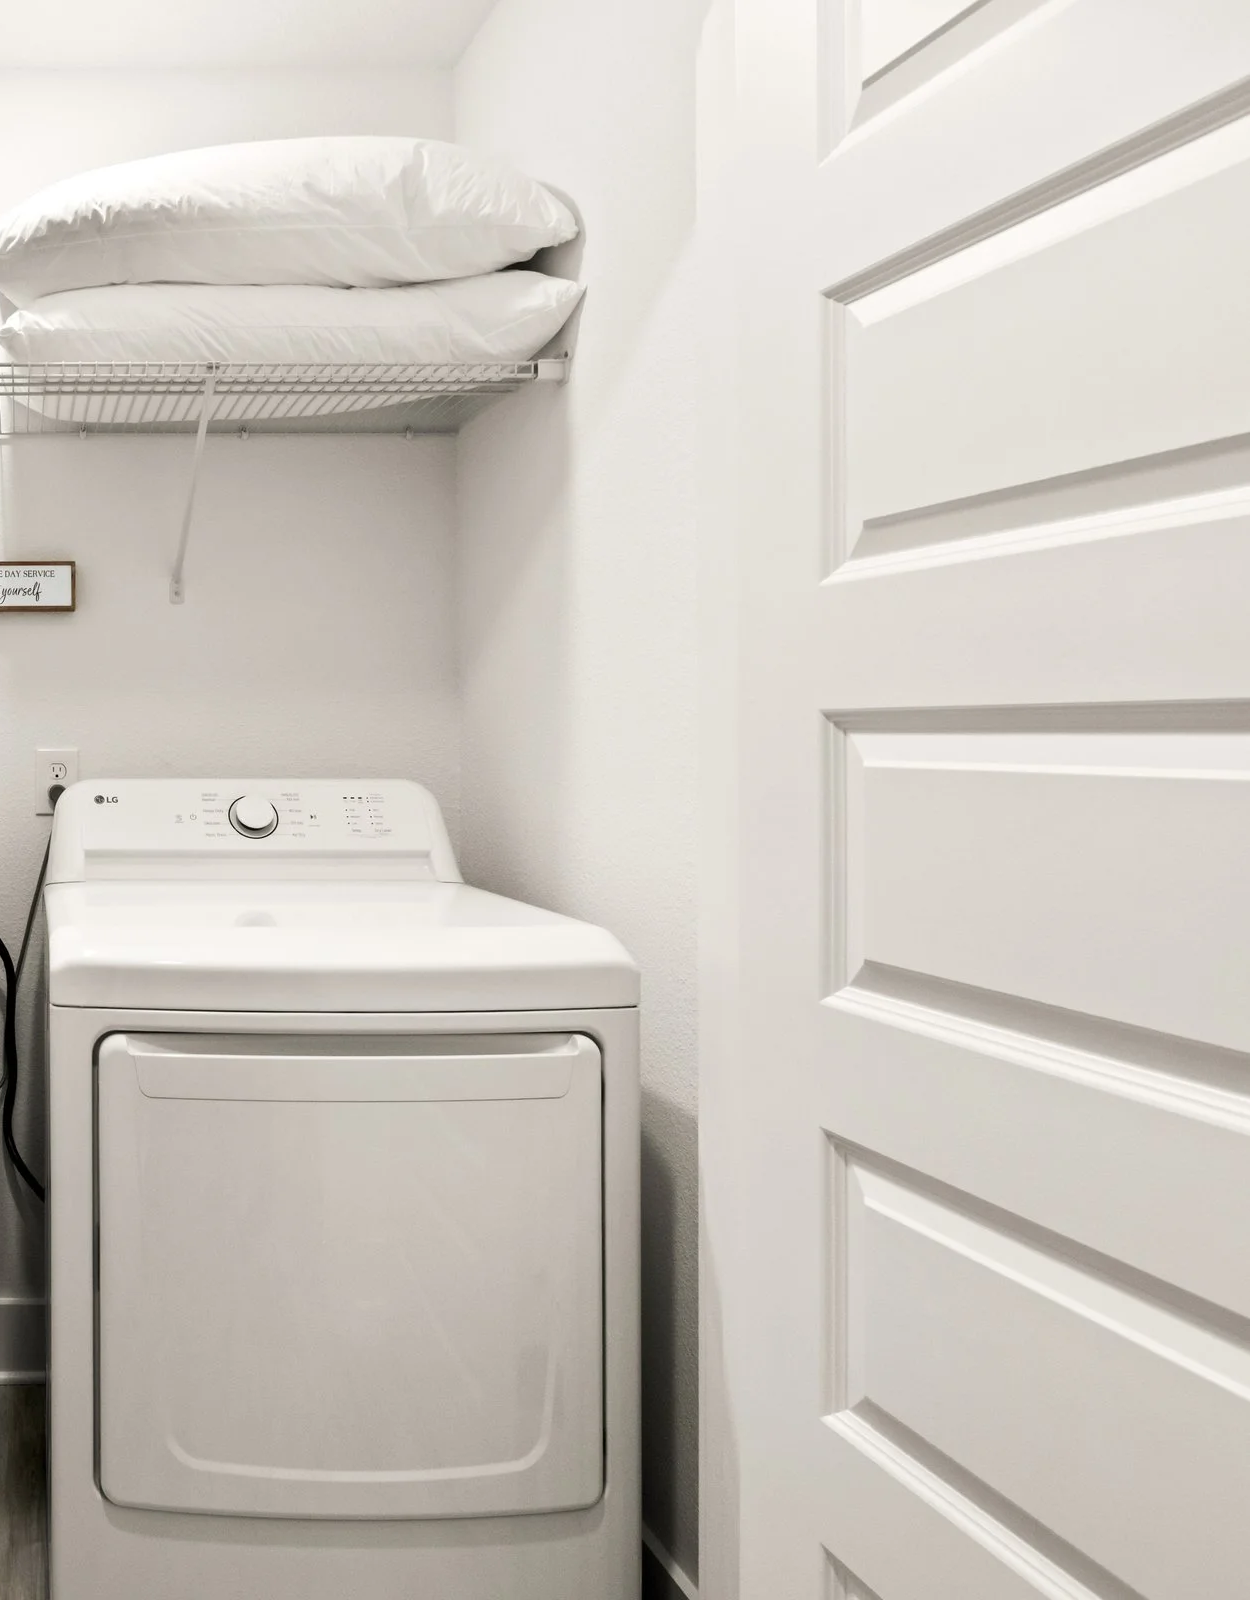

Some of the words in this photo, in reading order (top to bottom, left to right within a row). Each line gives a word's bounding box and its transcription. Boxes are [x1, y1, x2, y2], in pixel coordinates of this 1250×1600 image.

[4, 570, 22, 578] DAY
[23, 570, 55, 578] SERVICE
[0, 581, 42, 604] yourself
